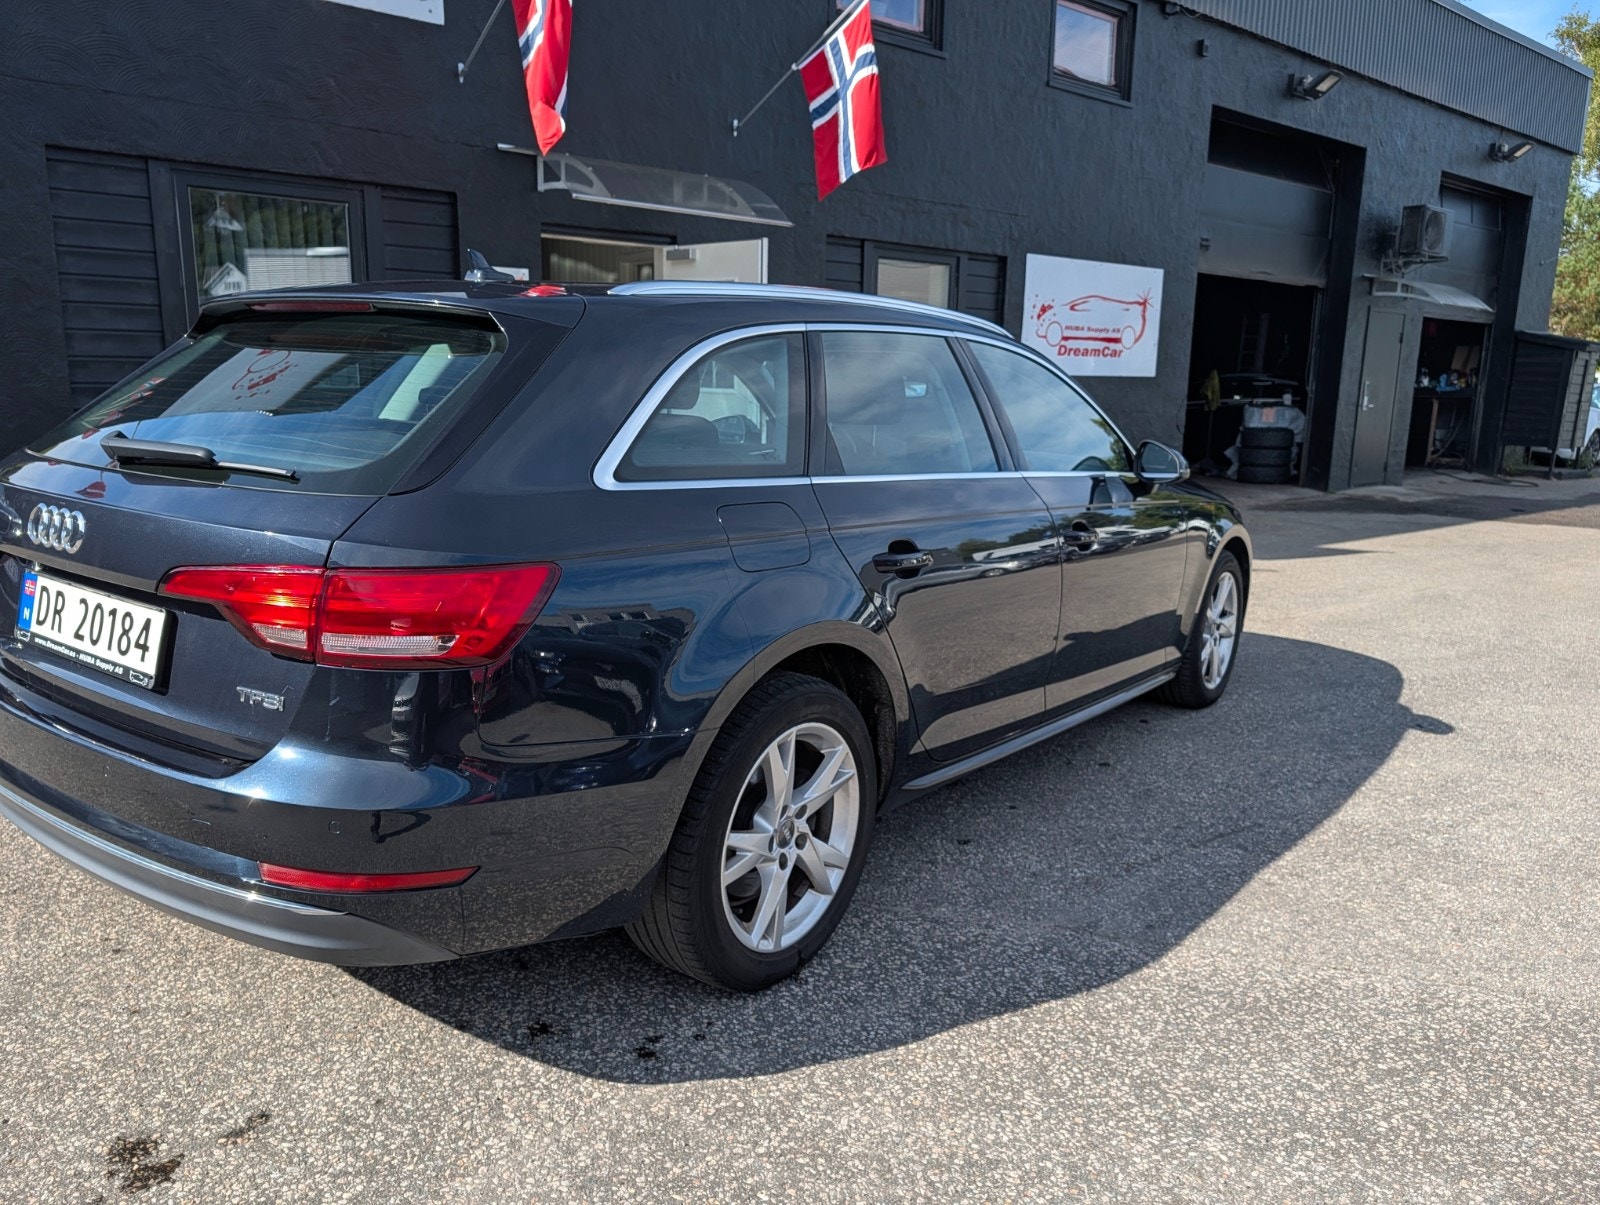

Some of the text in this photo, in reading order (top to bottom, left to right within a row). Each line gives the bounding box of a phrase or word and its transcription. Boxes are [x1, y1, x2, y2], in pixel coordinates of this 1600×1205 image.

[1057, 345, 1123, 358] DreamCar
[24, 607, 30, 621] N
[36, 585, 152, 662] DR 20184
[79, 653, 95, 665] HUBA
[95, 659, 114, 672] Supply
[114, 666, 123, 674] AS
[236, 686, 284, 711] TFSI
